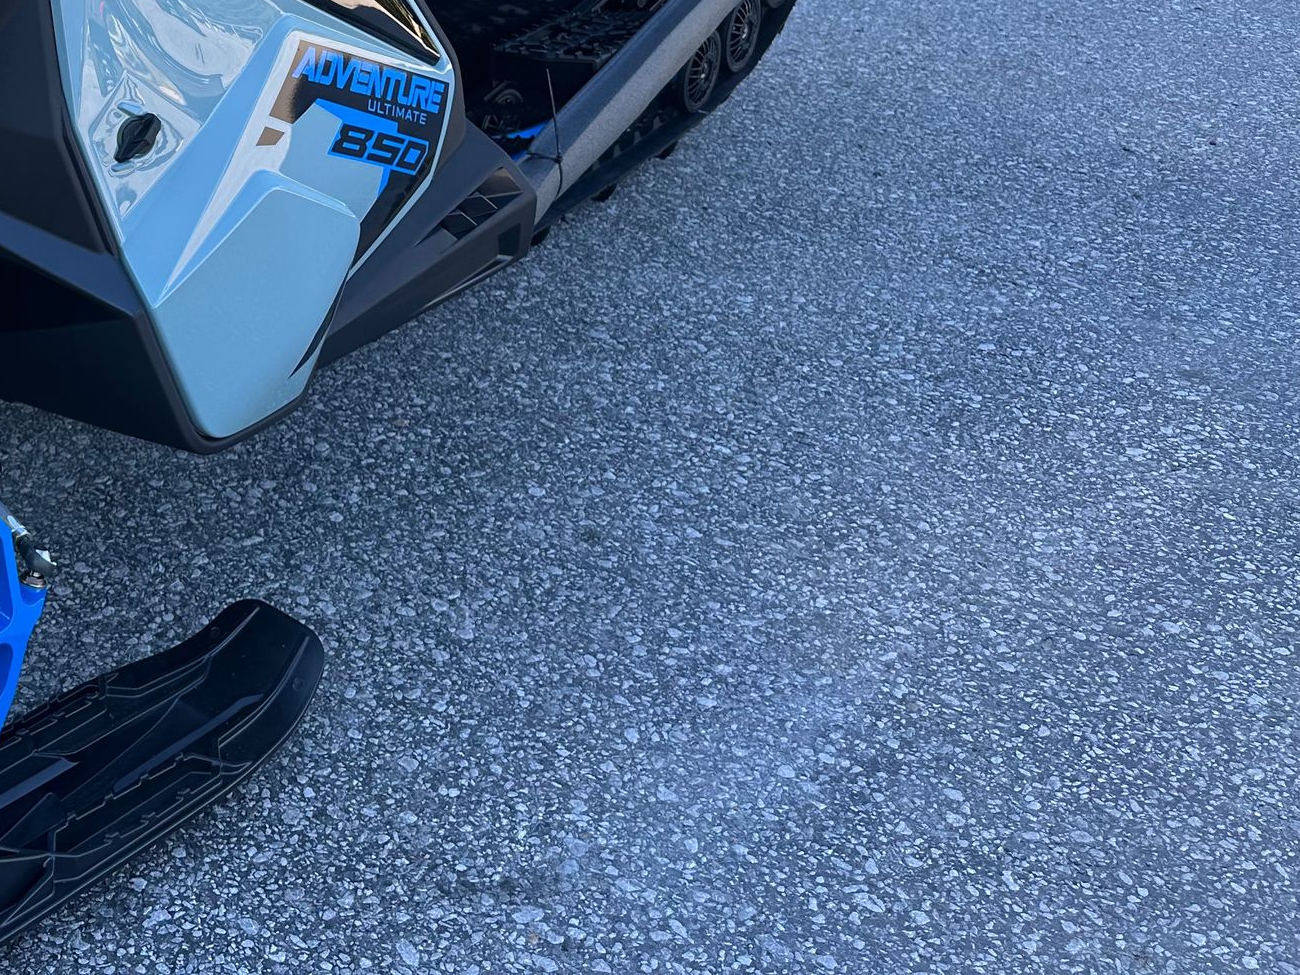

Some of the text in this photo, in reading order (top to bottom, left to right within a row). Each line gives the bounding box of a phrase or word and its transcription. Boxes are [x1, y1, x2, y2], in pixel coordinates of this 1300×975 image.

[292, 46, 445, 114] ADVENTURE
[367, 99, 428, 125] ULTIMATE
[330, 123, 428, 173] 850
